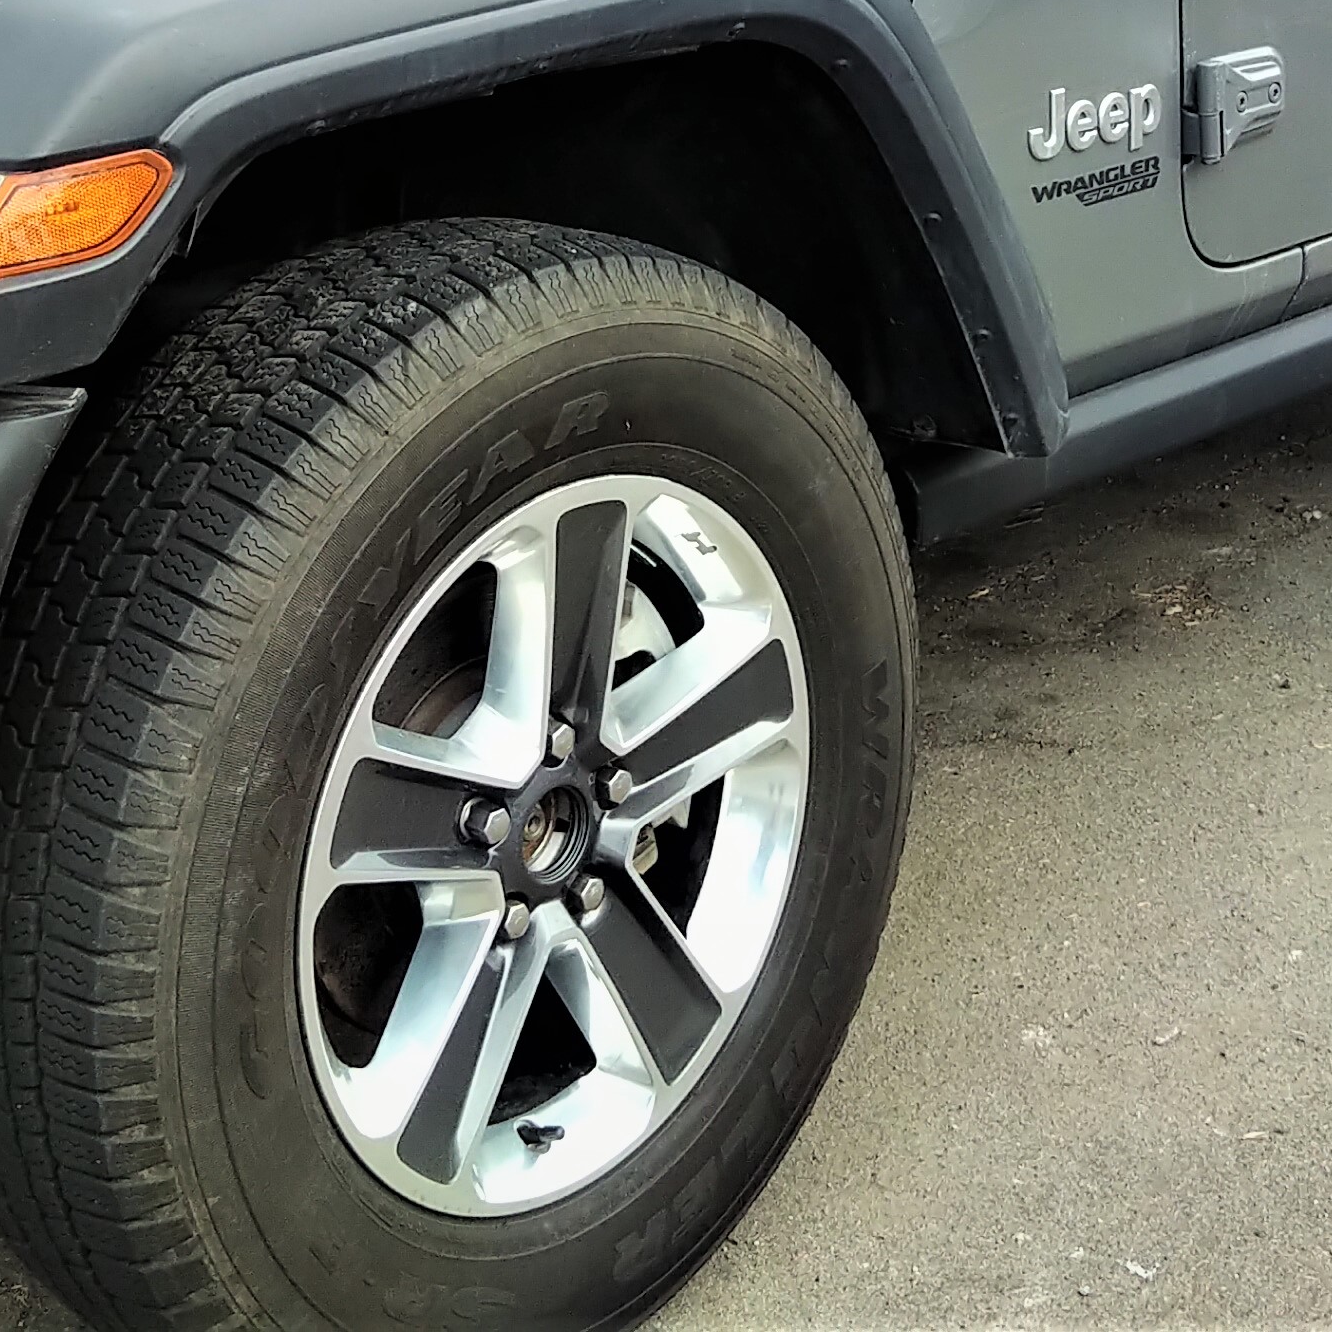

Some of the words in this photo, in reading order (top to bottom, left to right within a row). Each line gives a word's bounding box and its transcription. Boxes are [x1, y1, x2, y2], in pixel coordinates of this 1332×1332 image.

[1027, 83, 1161, 161] Jeep
[1031, 155, 1161, 203] WRANGLER
[1082, 176, 1159, 203] SPORT
